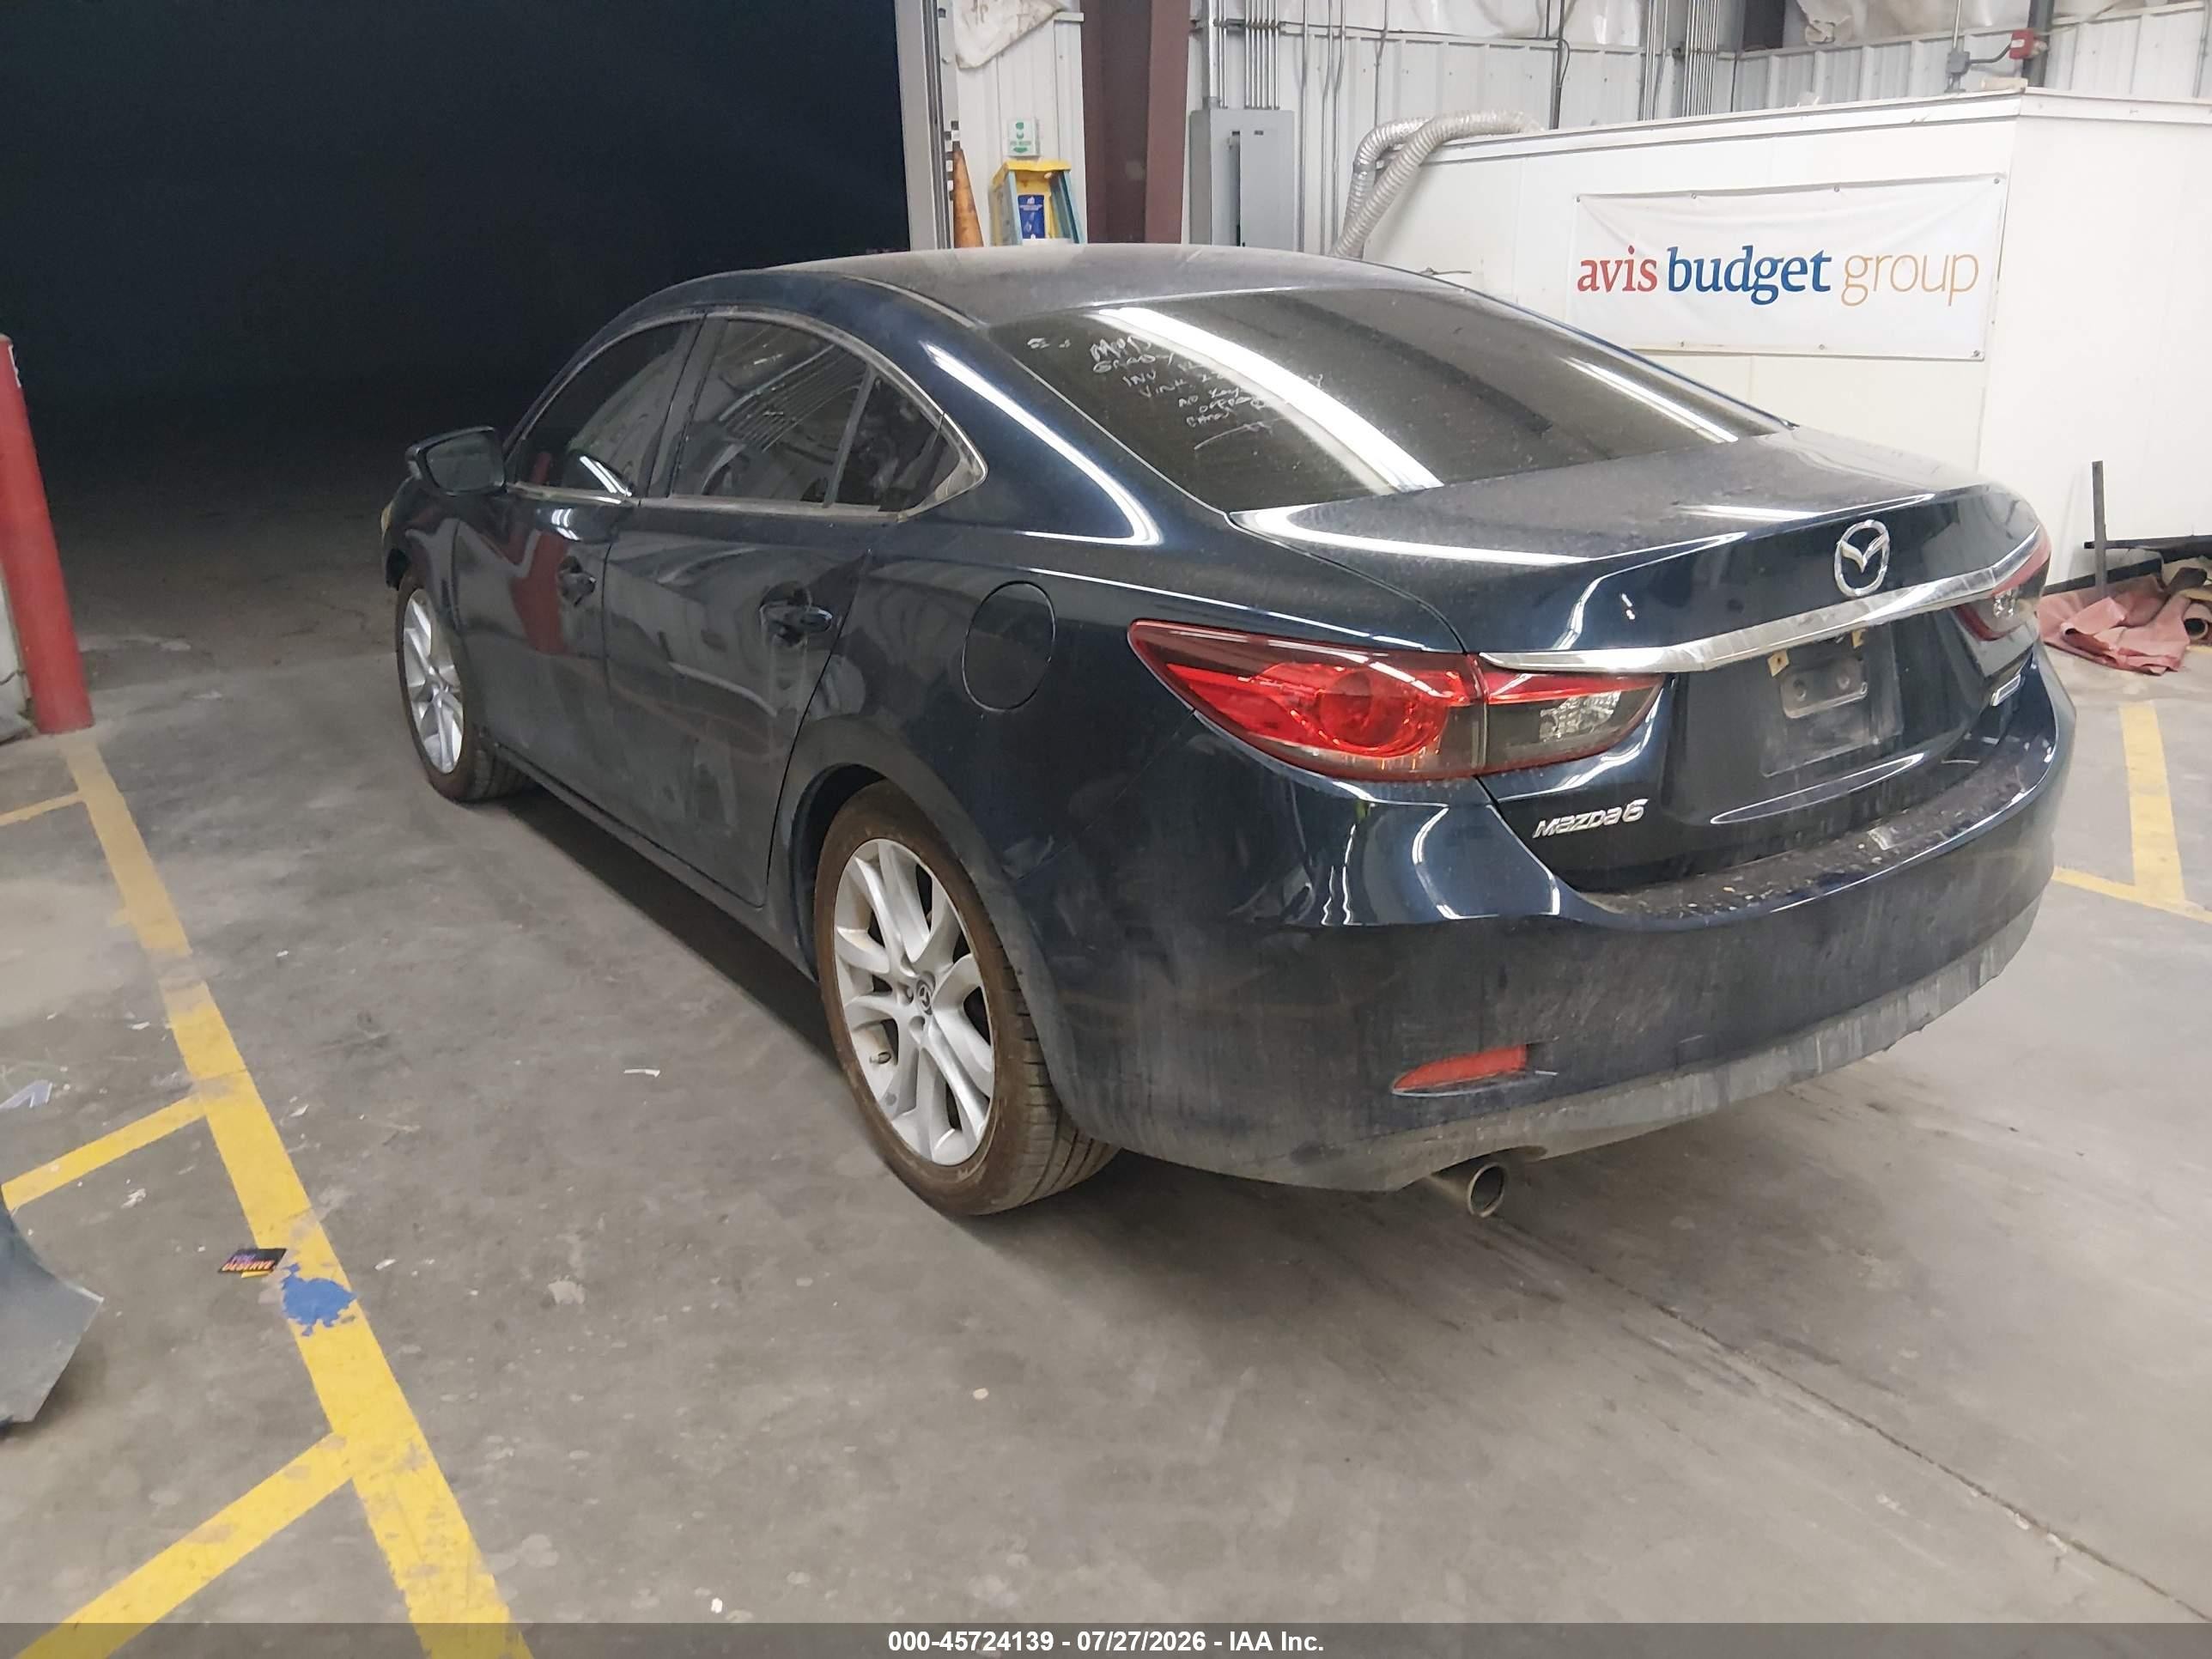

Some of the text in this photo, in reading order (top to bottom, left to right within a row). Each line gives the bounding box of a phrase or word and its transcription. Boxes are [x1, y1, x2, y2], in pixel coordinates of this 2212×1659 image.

[1577, 246, 1979, 307] avis budget group
